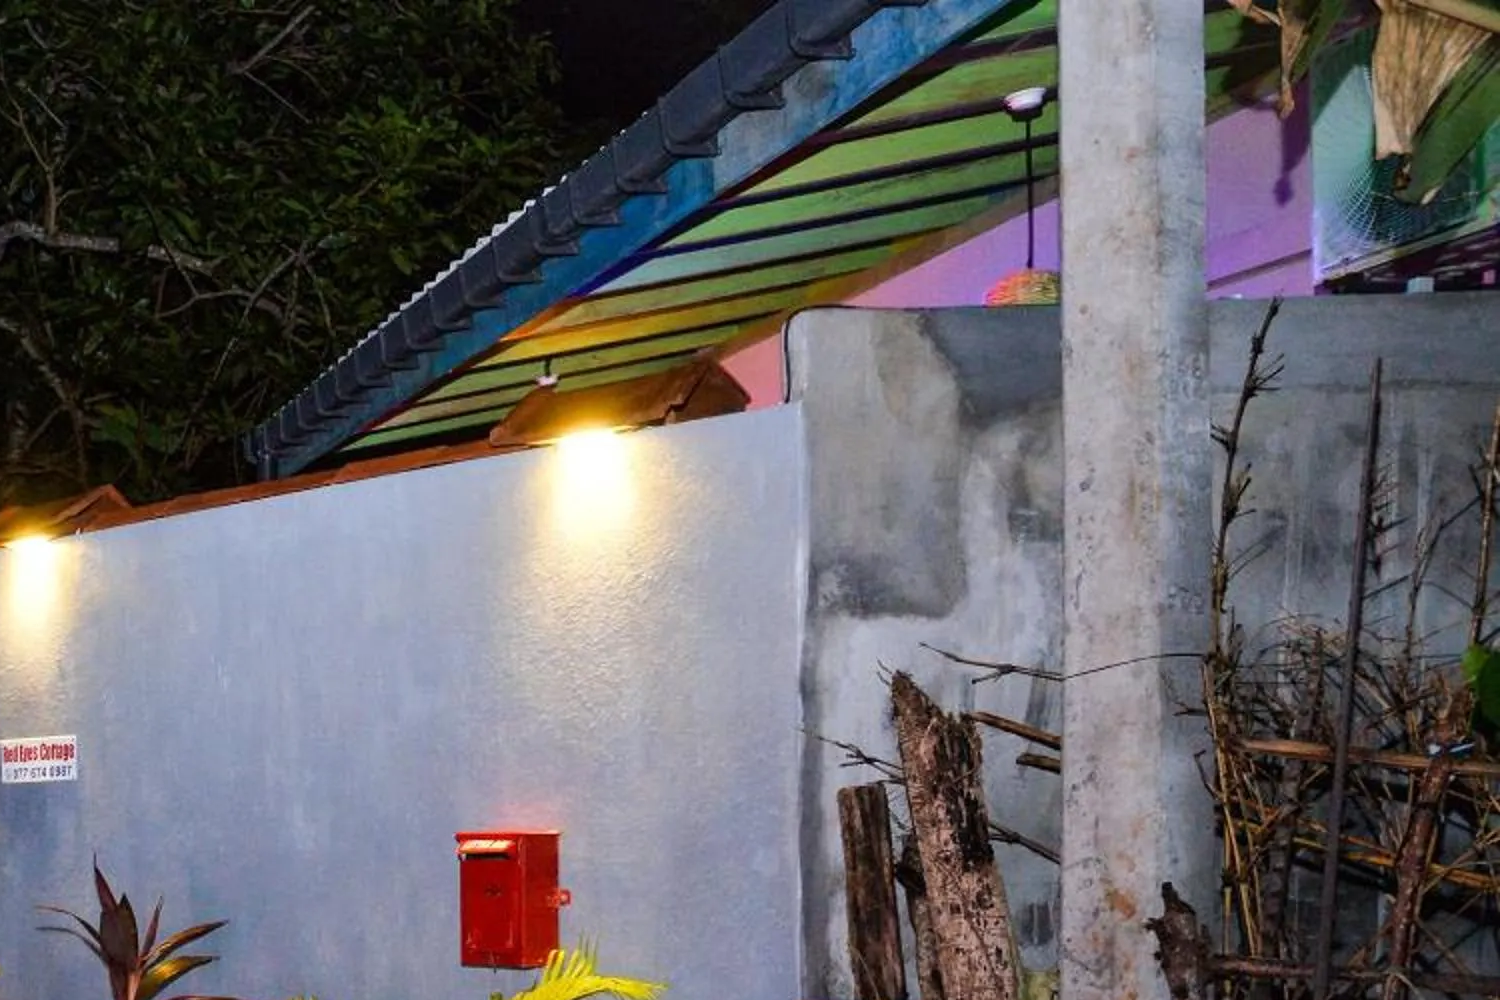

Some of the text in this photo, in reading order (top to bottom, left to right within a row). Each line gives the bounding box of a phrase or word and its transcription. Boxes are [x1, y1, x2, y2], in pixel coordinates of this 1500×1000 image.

[3, 742, 75, 763] Red Eyes Cottage
